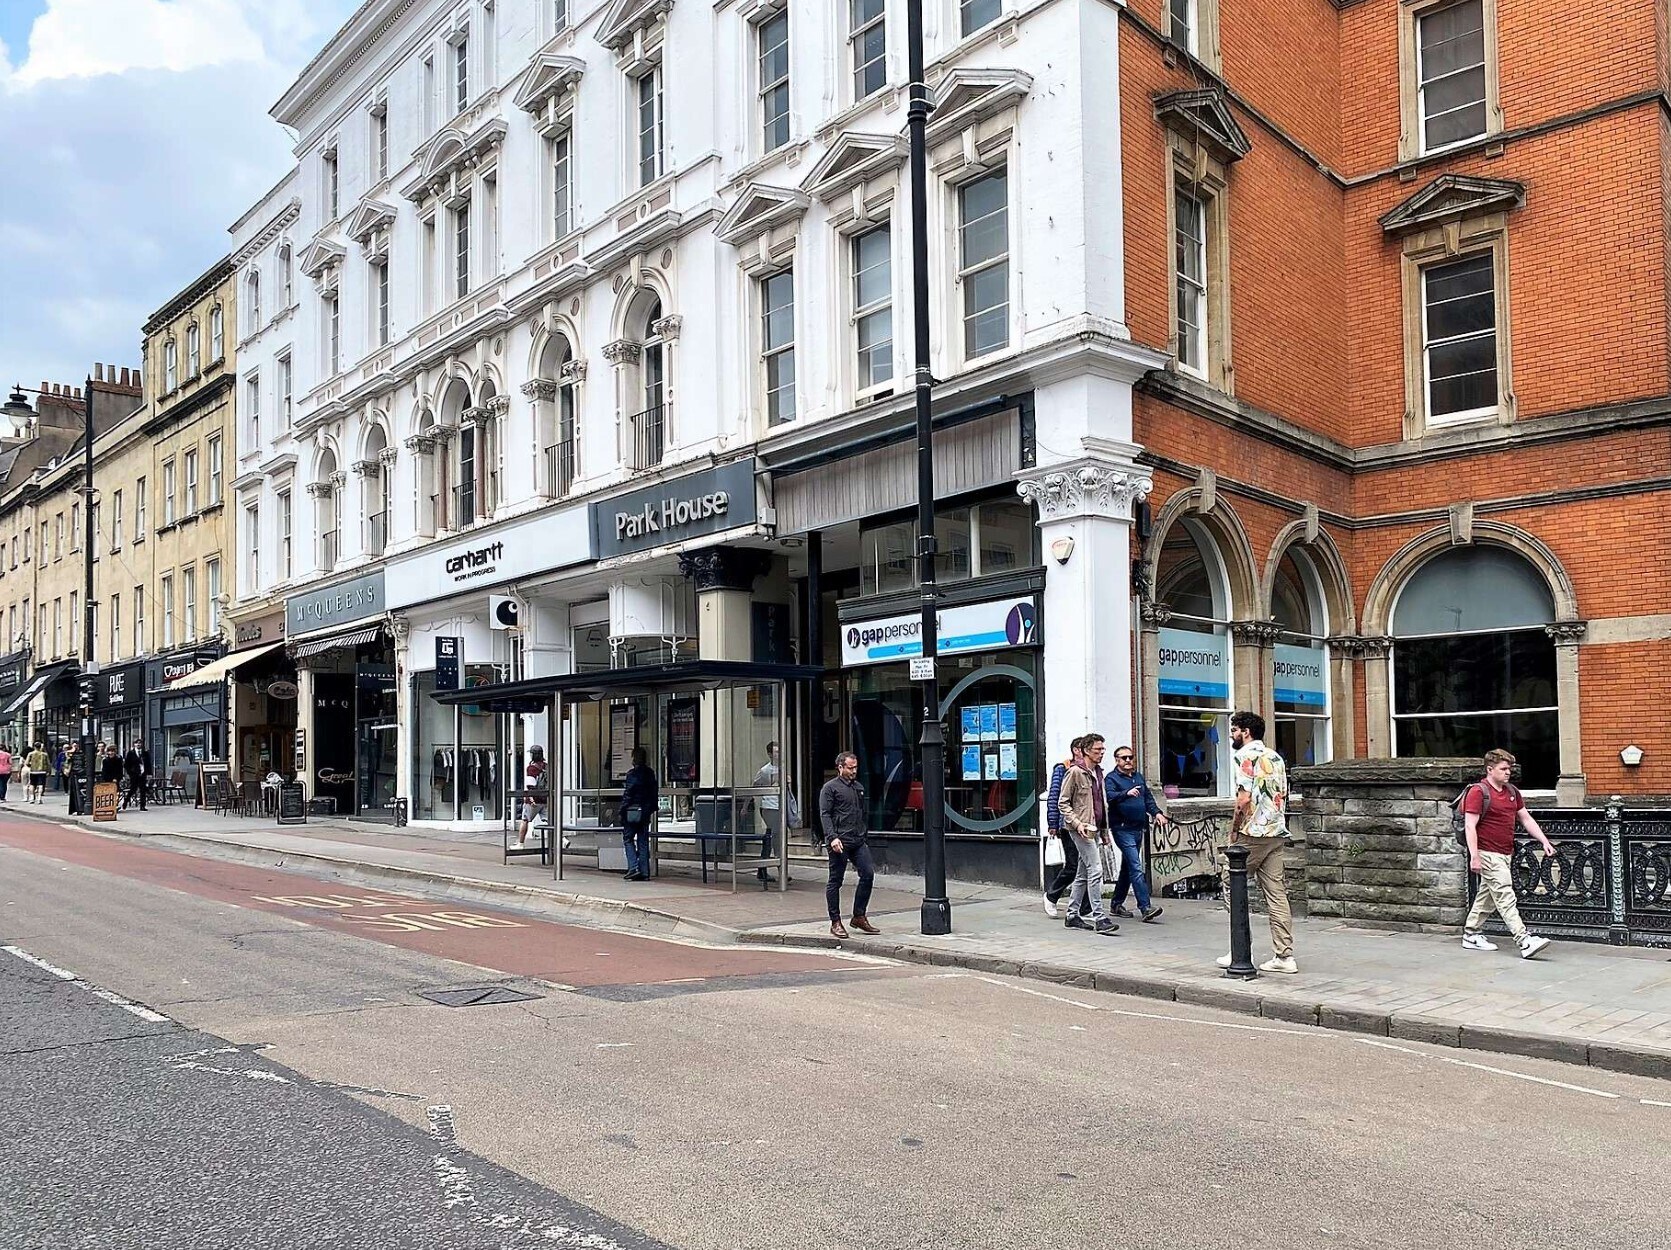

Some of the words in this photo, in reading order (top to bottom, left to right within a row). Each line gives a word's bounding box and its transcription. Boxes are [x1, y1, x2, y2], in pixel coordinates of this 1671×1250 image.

[615, 503, 660, 540] Park
[661, 491, 729, 529] House
[446, 541, 504, 574] carhartt
[297, 585, 375, 622] McQUEENS
[861, 614, 942, 646] gappersonl
[1158, 648, 1222, 668] gappersonnel
[109, 673, 125, 693] PURE
[923, 706, 930, 717] 2
[95, 793, 115, 809] BEER
[342, 911, 531, 932] BUS
